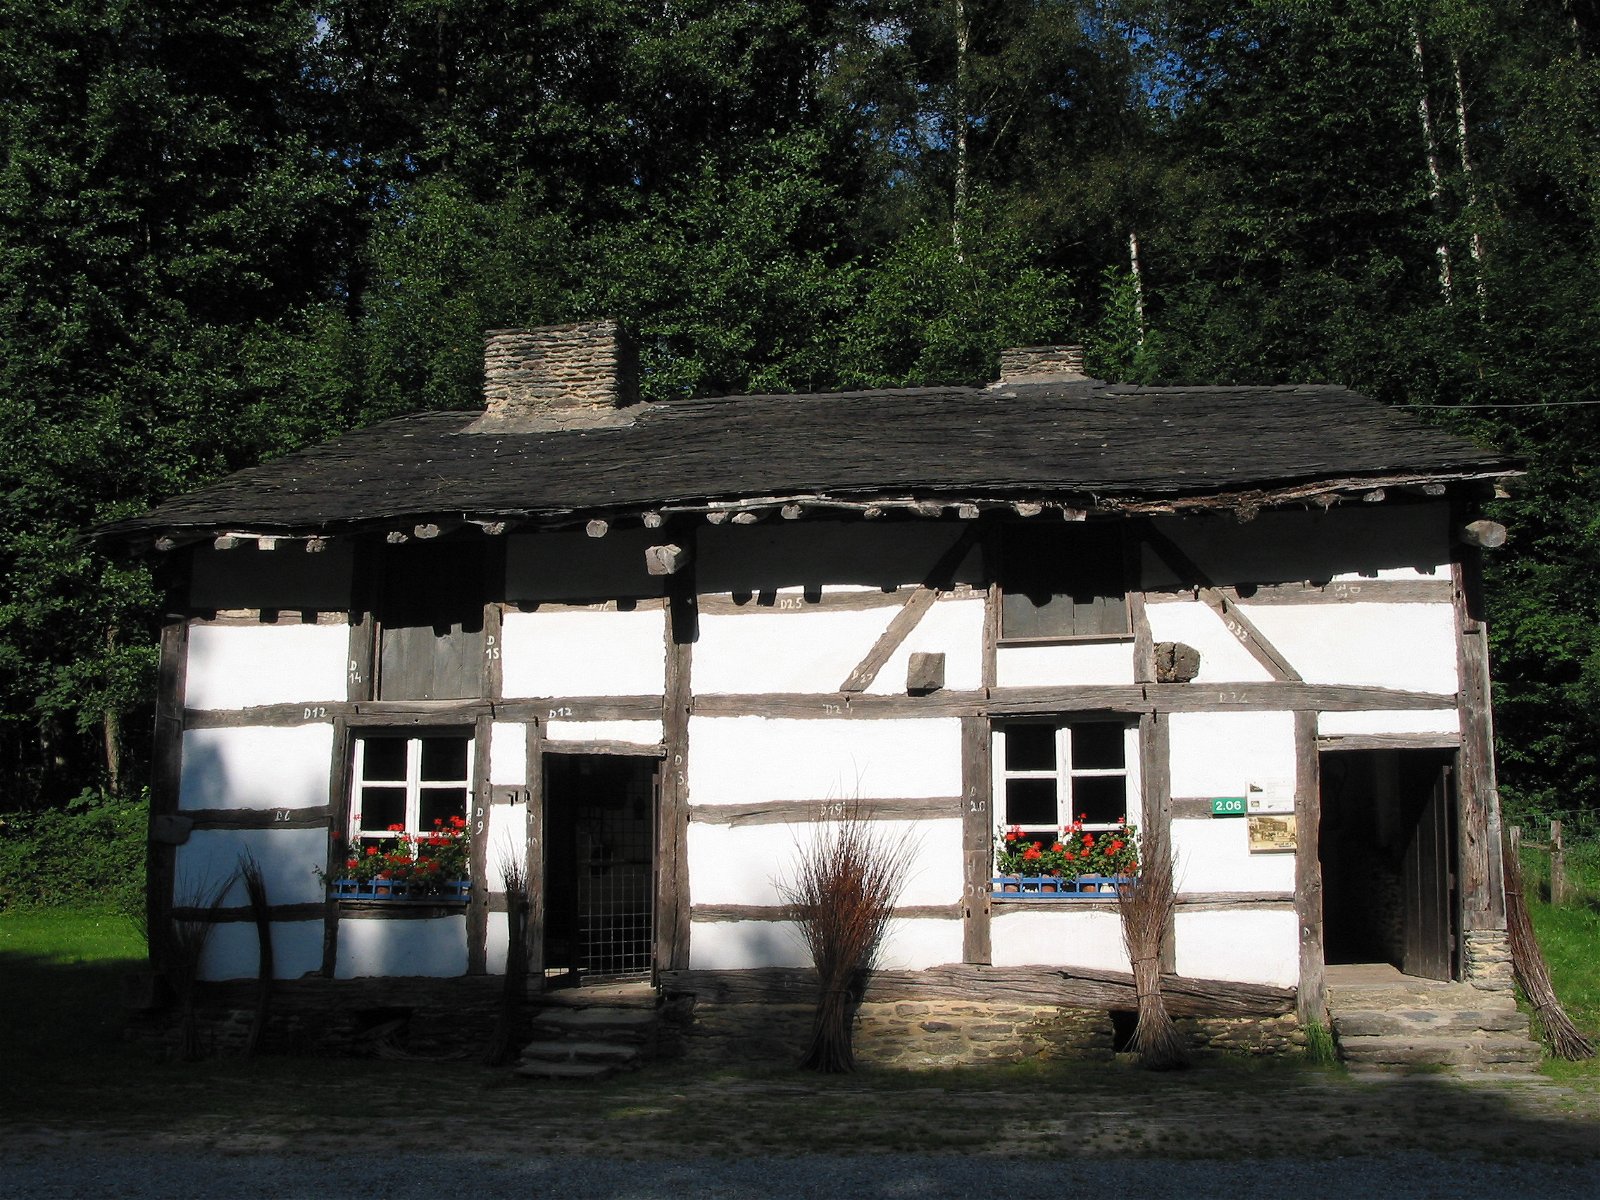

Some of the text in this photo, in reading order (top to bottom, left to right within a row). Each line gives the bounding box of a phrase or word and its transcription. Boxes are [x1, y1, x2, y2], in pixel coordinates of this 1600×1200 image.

[780, 597, 803, 610] D25
[1227, 620, 1248, 642] D32
[486, 635, 495, 646] D
[485, 647, 500, 660] 15
[349, 660, 358, 671] D
[348, 672, 362, 684] 14
[303, 707, 328, 720] D12
[548, 707, 573, 719] D12
[1215, 800, 1242, 811] 2.06
[475, 807, 484, 817] D
[475, 820, 484, 835] 9
